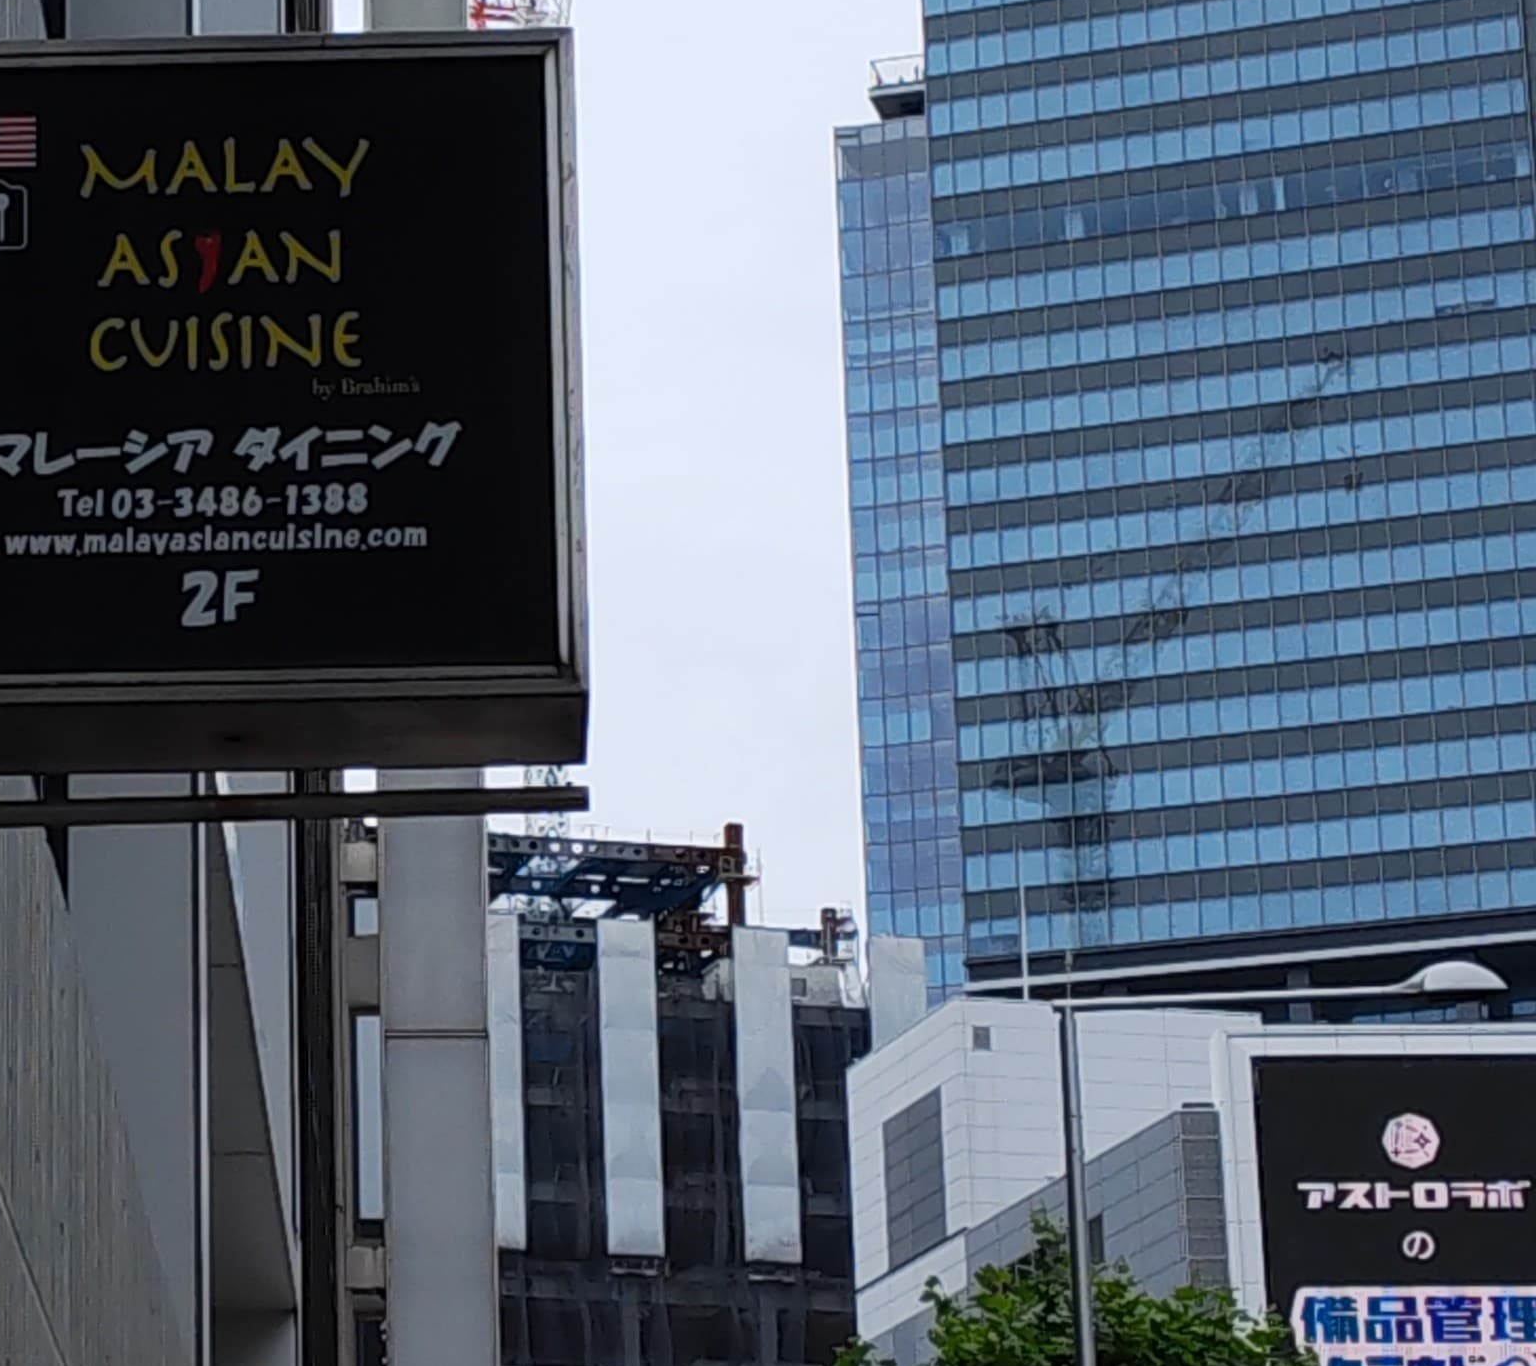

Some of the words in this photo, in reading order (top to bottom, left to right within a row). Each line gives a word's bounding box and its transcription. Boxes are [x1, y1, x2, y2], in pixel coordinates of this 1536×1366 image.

[79, 137, 370, 198] MALAY
[97, 229, 342, 293] ASIAN
[88, 310, 362, 371] CUISINE
[311, 376, 335, 402] by
[233, 421, 462, 473] ダイニング
[58, 489, 104, 519] Tel
[111, 483, 369, 520] 03-3486-1388
[4, 523, 428, 558] www.malayasiancuisine.com
[181, 569, 261, 628] 2F
[1297, 1180, 1531, 1209] アストロラボ
[1402, 1231, 1436, 1260] の
[1300, 1296, 1536, 1344] 備品管理
